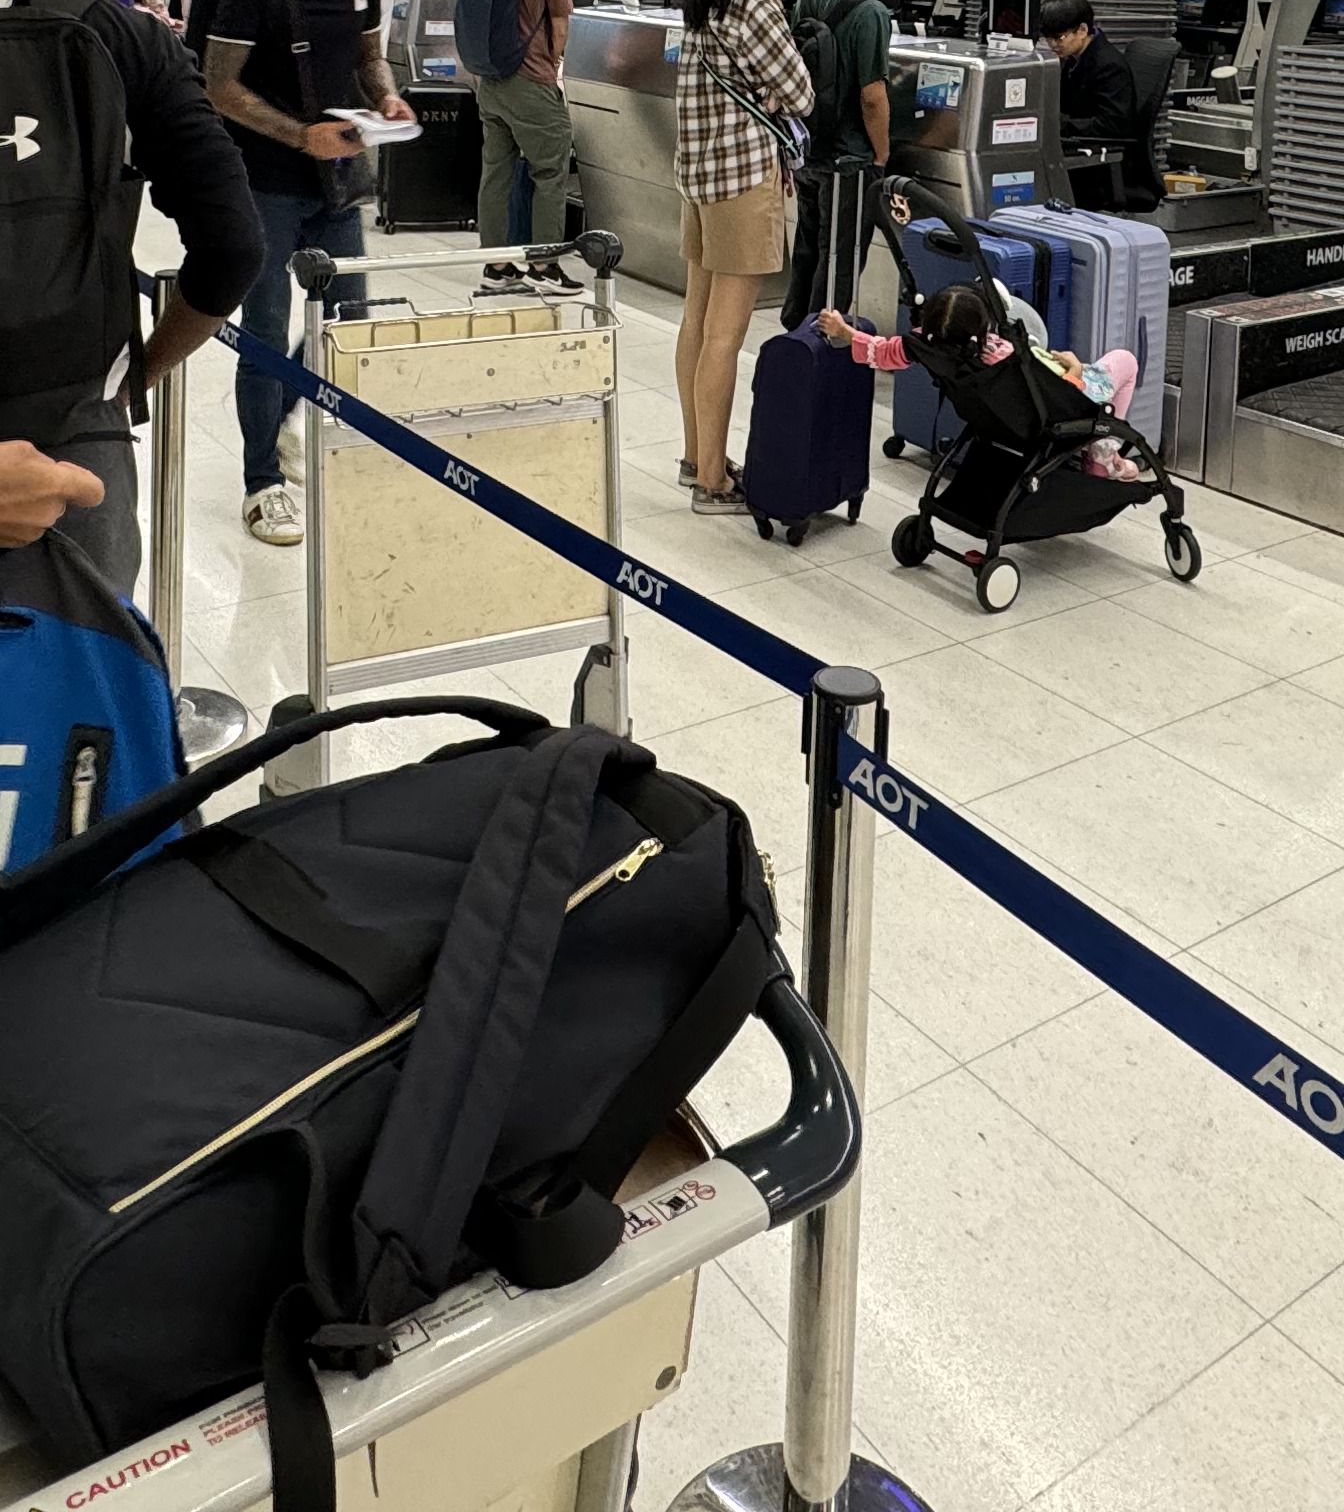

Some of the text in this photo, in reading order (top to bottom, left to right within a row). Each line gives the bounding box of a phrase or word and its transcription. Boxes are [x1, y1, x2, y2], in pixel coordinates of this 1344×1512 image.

[1285, 335, 1324, 354] WEIGH
[315, 383, 343, 413] AOT
[443, 459, 481, 497] AOT
[615, 560, 672, 608] AOT
[848, 757, 931, 831] AOT
[224, 1413, 268, 1439] RELEA
[65, 1438, 193, 1510] CAUTION
